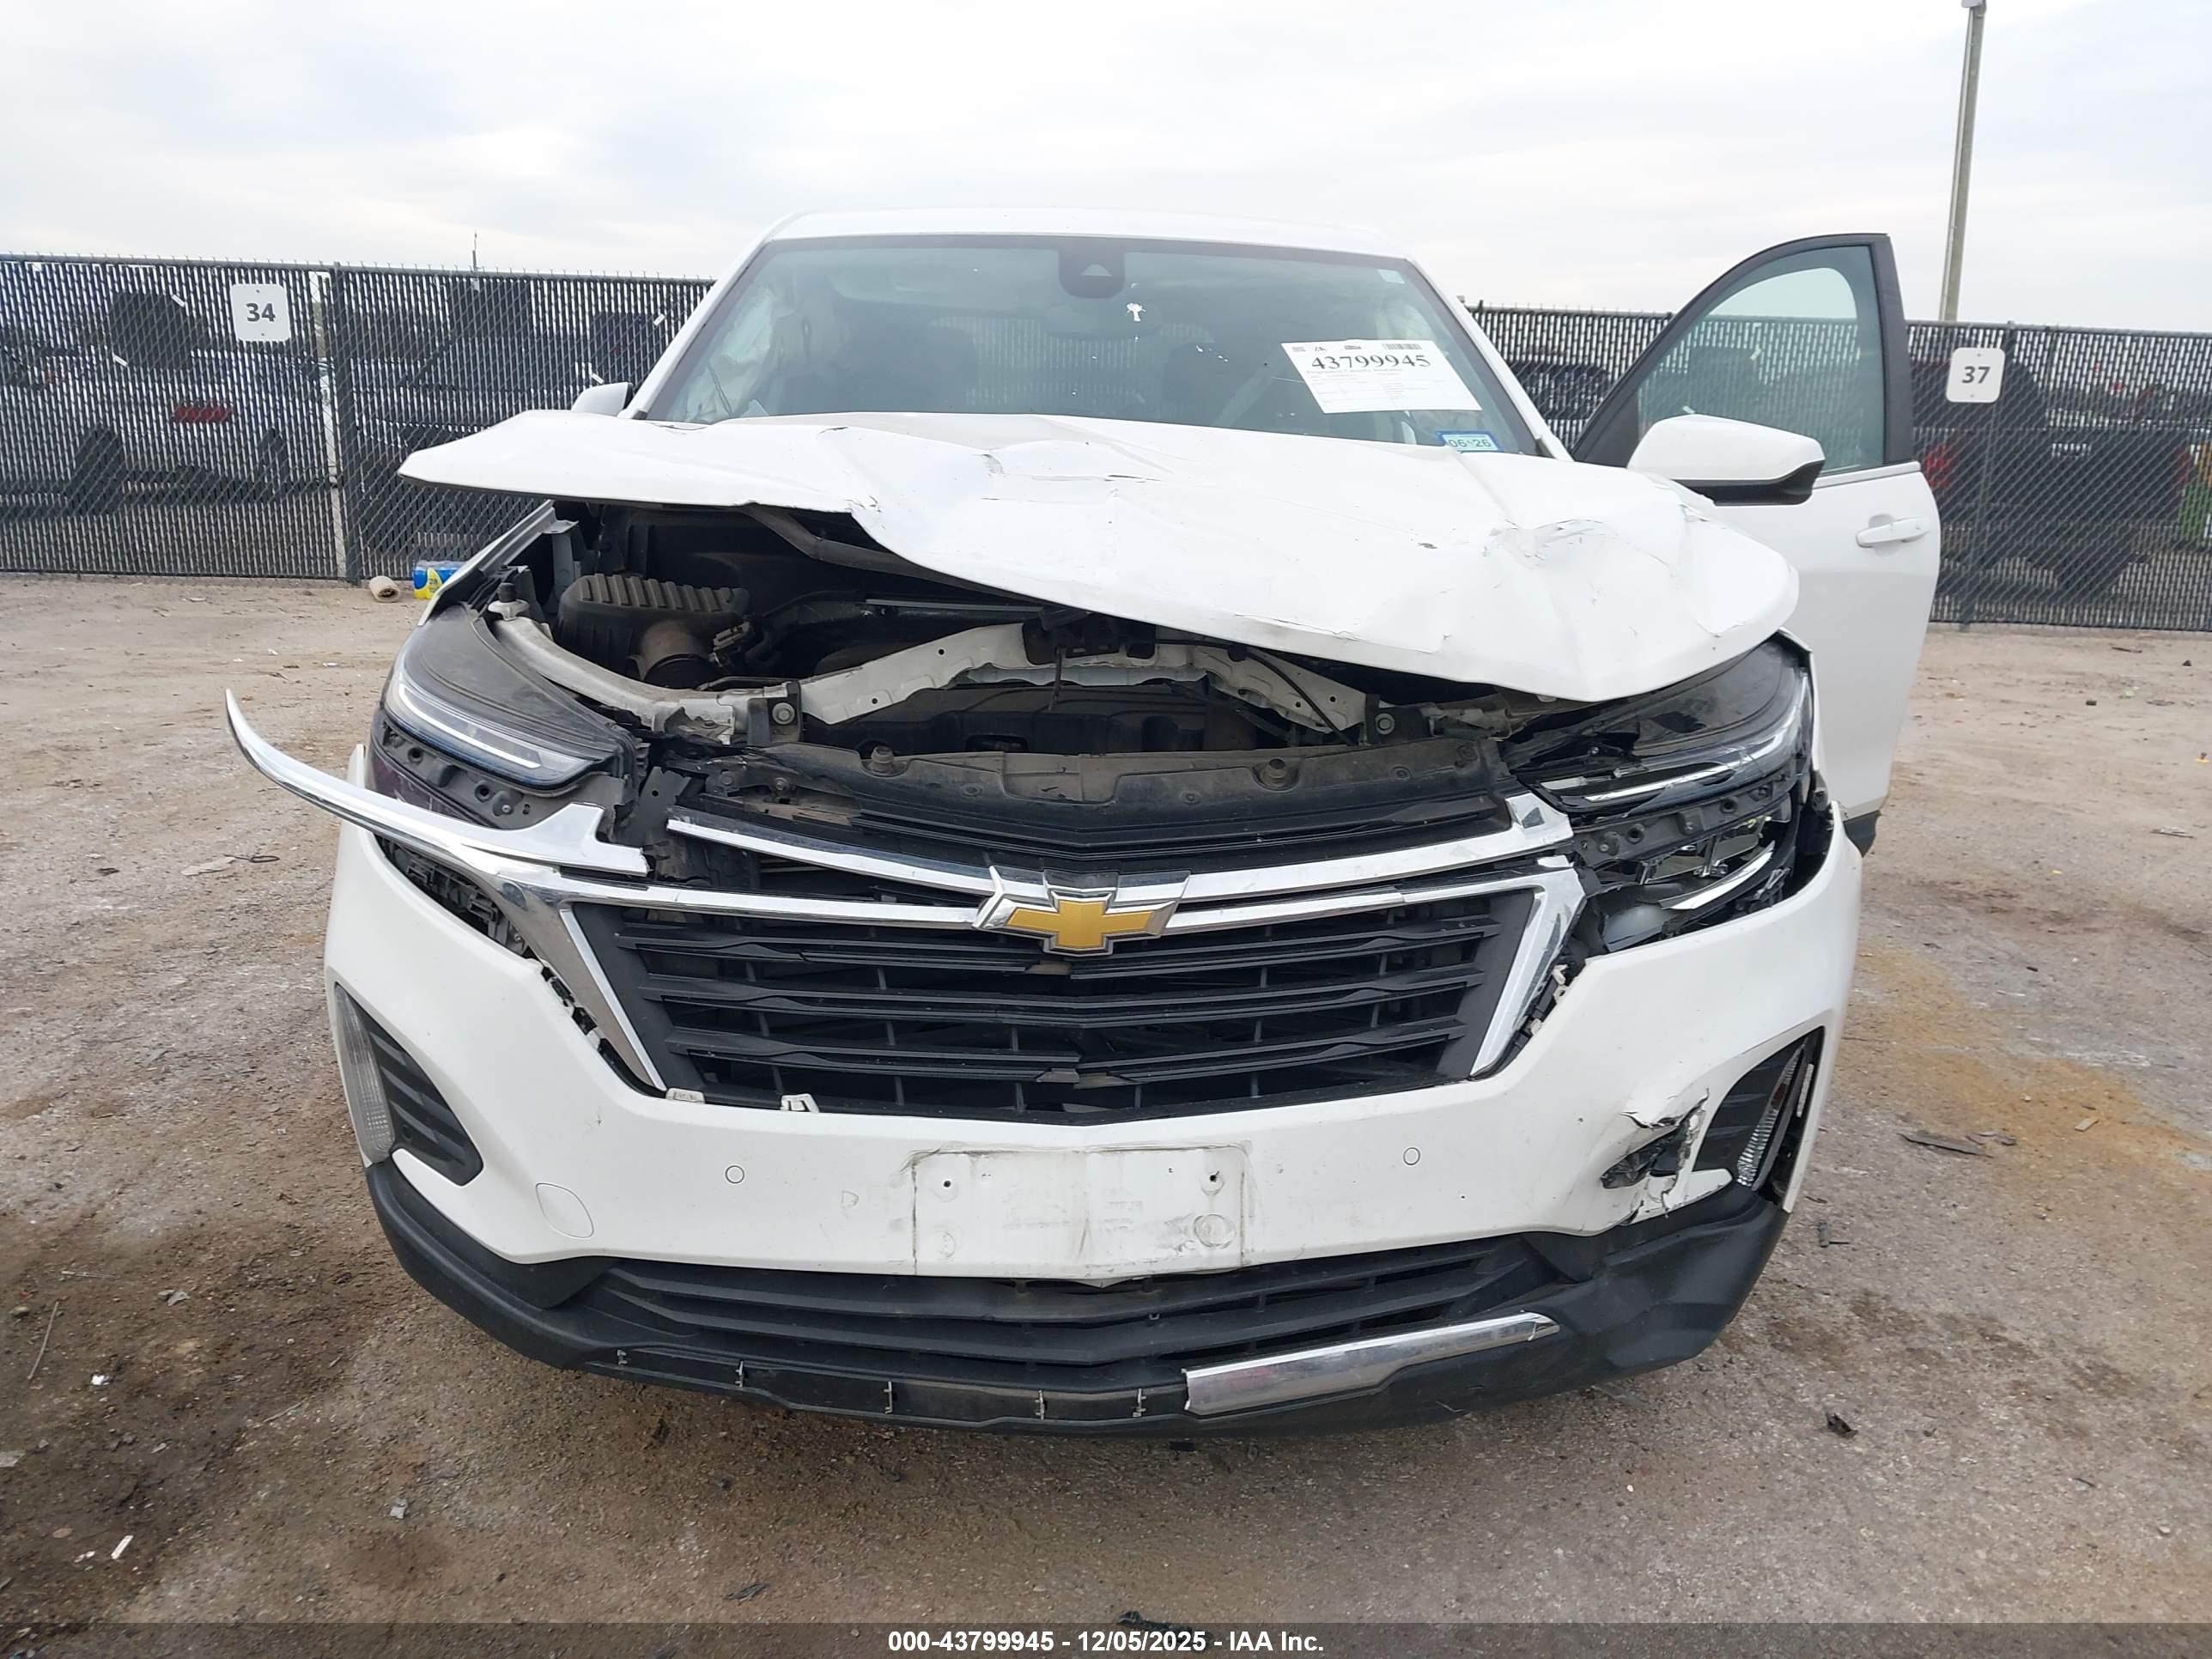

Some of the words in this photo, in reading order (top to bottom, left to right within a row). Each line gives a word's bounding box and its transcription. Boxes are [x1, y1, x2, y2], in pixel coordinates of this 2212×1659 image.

[246, 302, 276, 322] 34
[1311, 354, 1431, 369] 43799945
[1962, 366, 1990, 384] 37
[1449, 439, 1468, 447] 06
[1473, 439, 1492, 447] 26
